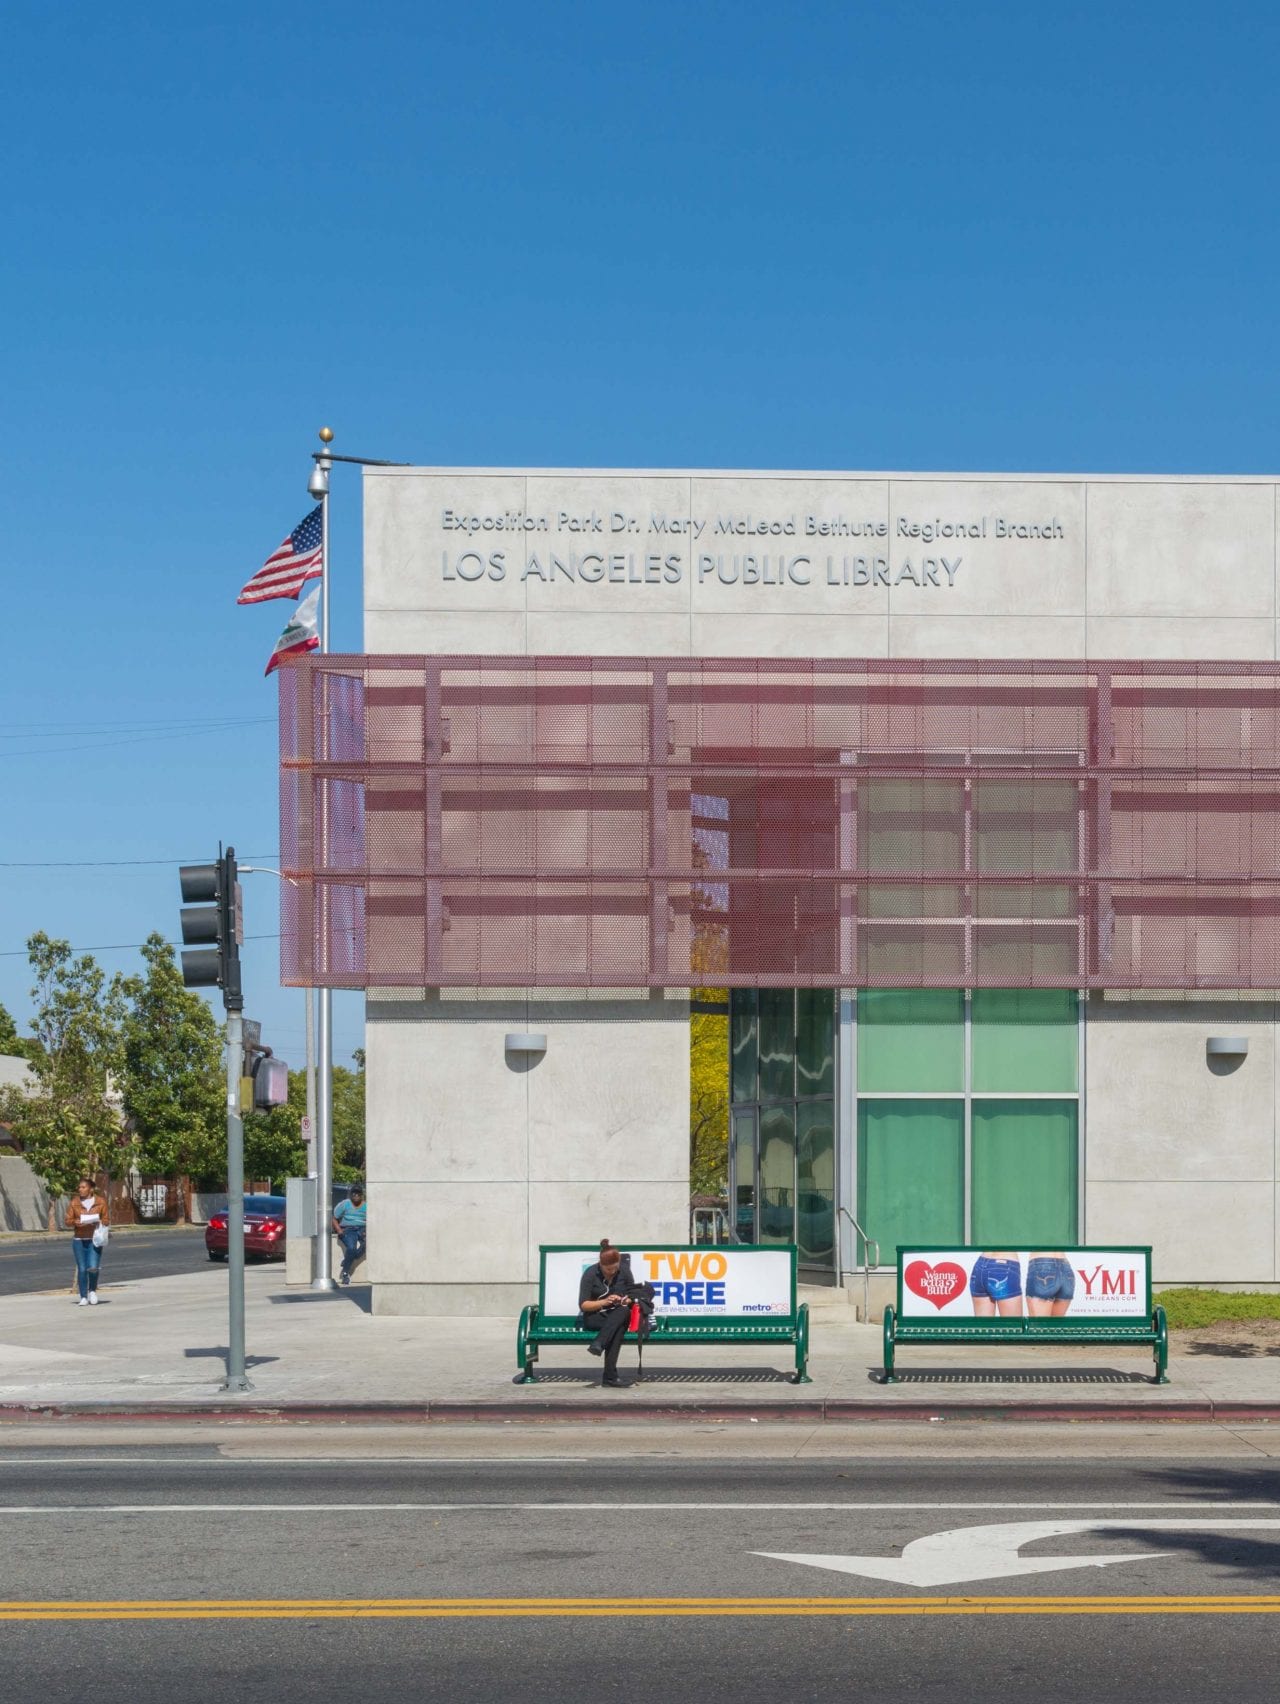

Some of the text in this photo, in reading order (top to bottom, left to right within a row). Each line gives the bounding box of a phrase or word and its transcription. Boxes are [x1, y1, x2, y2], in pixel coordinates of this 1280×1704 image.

[443, 510, 1064, 543] Exposition Park Dr. Mary McLeod Bethune Regional Branch
[443, 550, 963, 588] LOS ANGELES PUBLIC LIBRARY
[643, 1253, 727, 1280] TWO
[923, 1270, 957, 1280] Wanna
[1077, 1264, 1136, 1295] YMI
[742, 1303, 789, 1312] metroPCS
